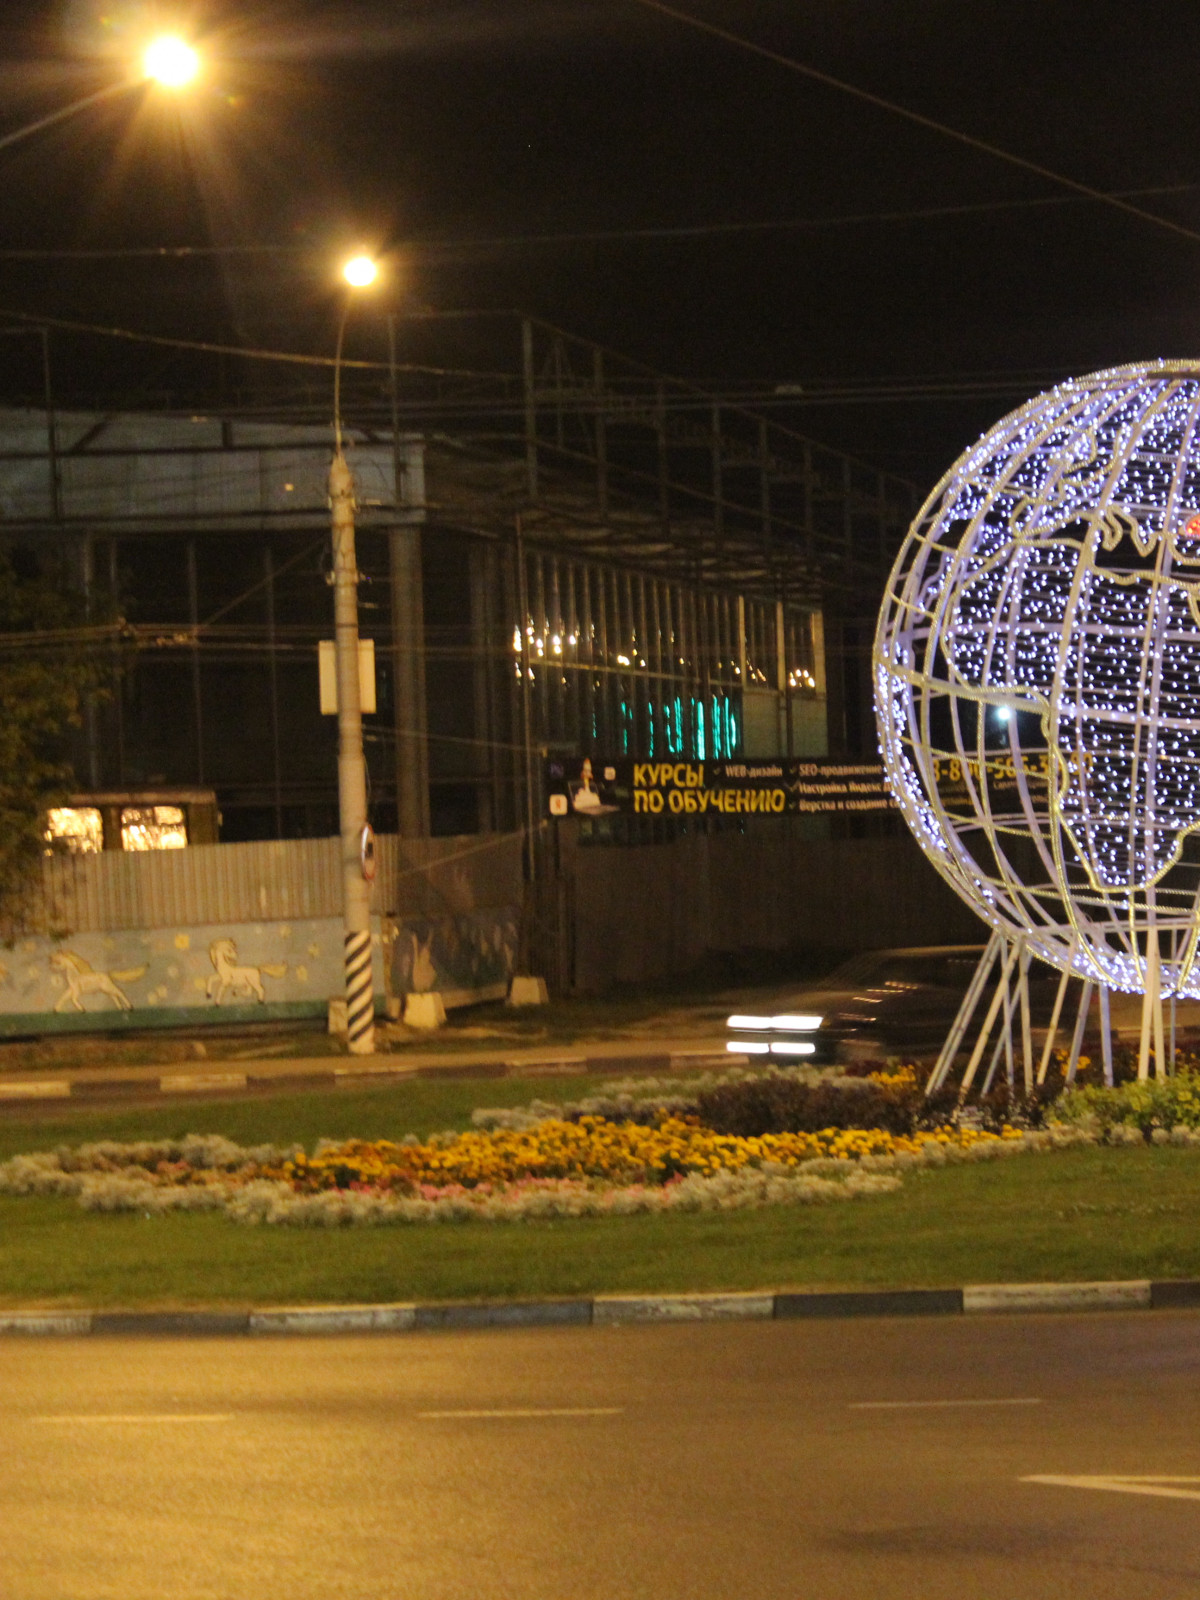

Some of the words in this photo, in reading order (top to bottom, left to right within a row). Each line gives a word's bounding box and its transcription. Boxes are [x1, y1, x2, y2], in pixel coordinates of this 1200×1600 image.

[633, 763, 704, 788] КУРСЫ
[725, 764, 783, 778] WEB-дизайн
[799, 763, 882, 778] SEO-продвижение
[799, 781, 848, 795] Настройка
[848, 781, 882, 793] Яндекс
[633, 791, 665, 814] ПО
[668, 788, 787, 814] ОБУЧЕНИЮ
[799, 799, 836, 812] Верстка
[837, 801, 845, 810] и
[846, 799, 888, 810] создание
